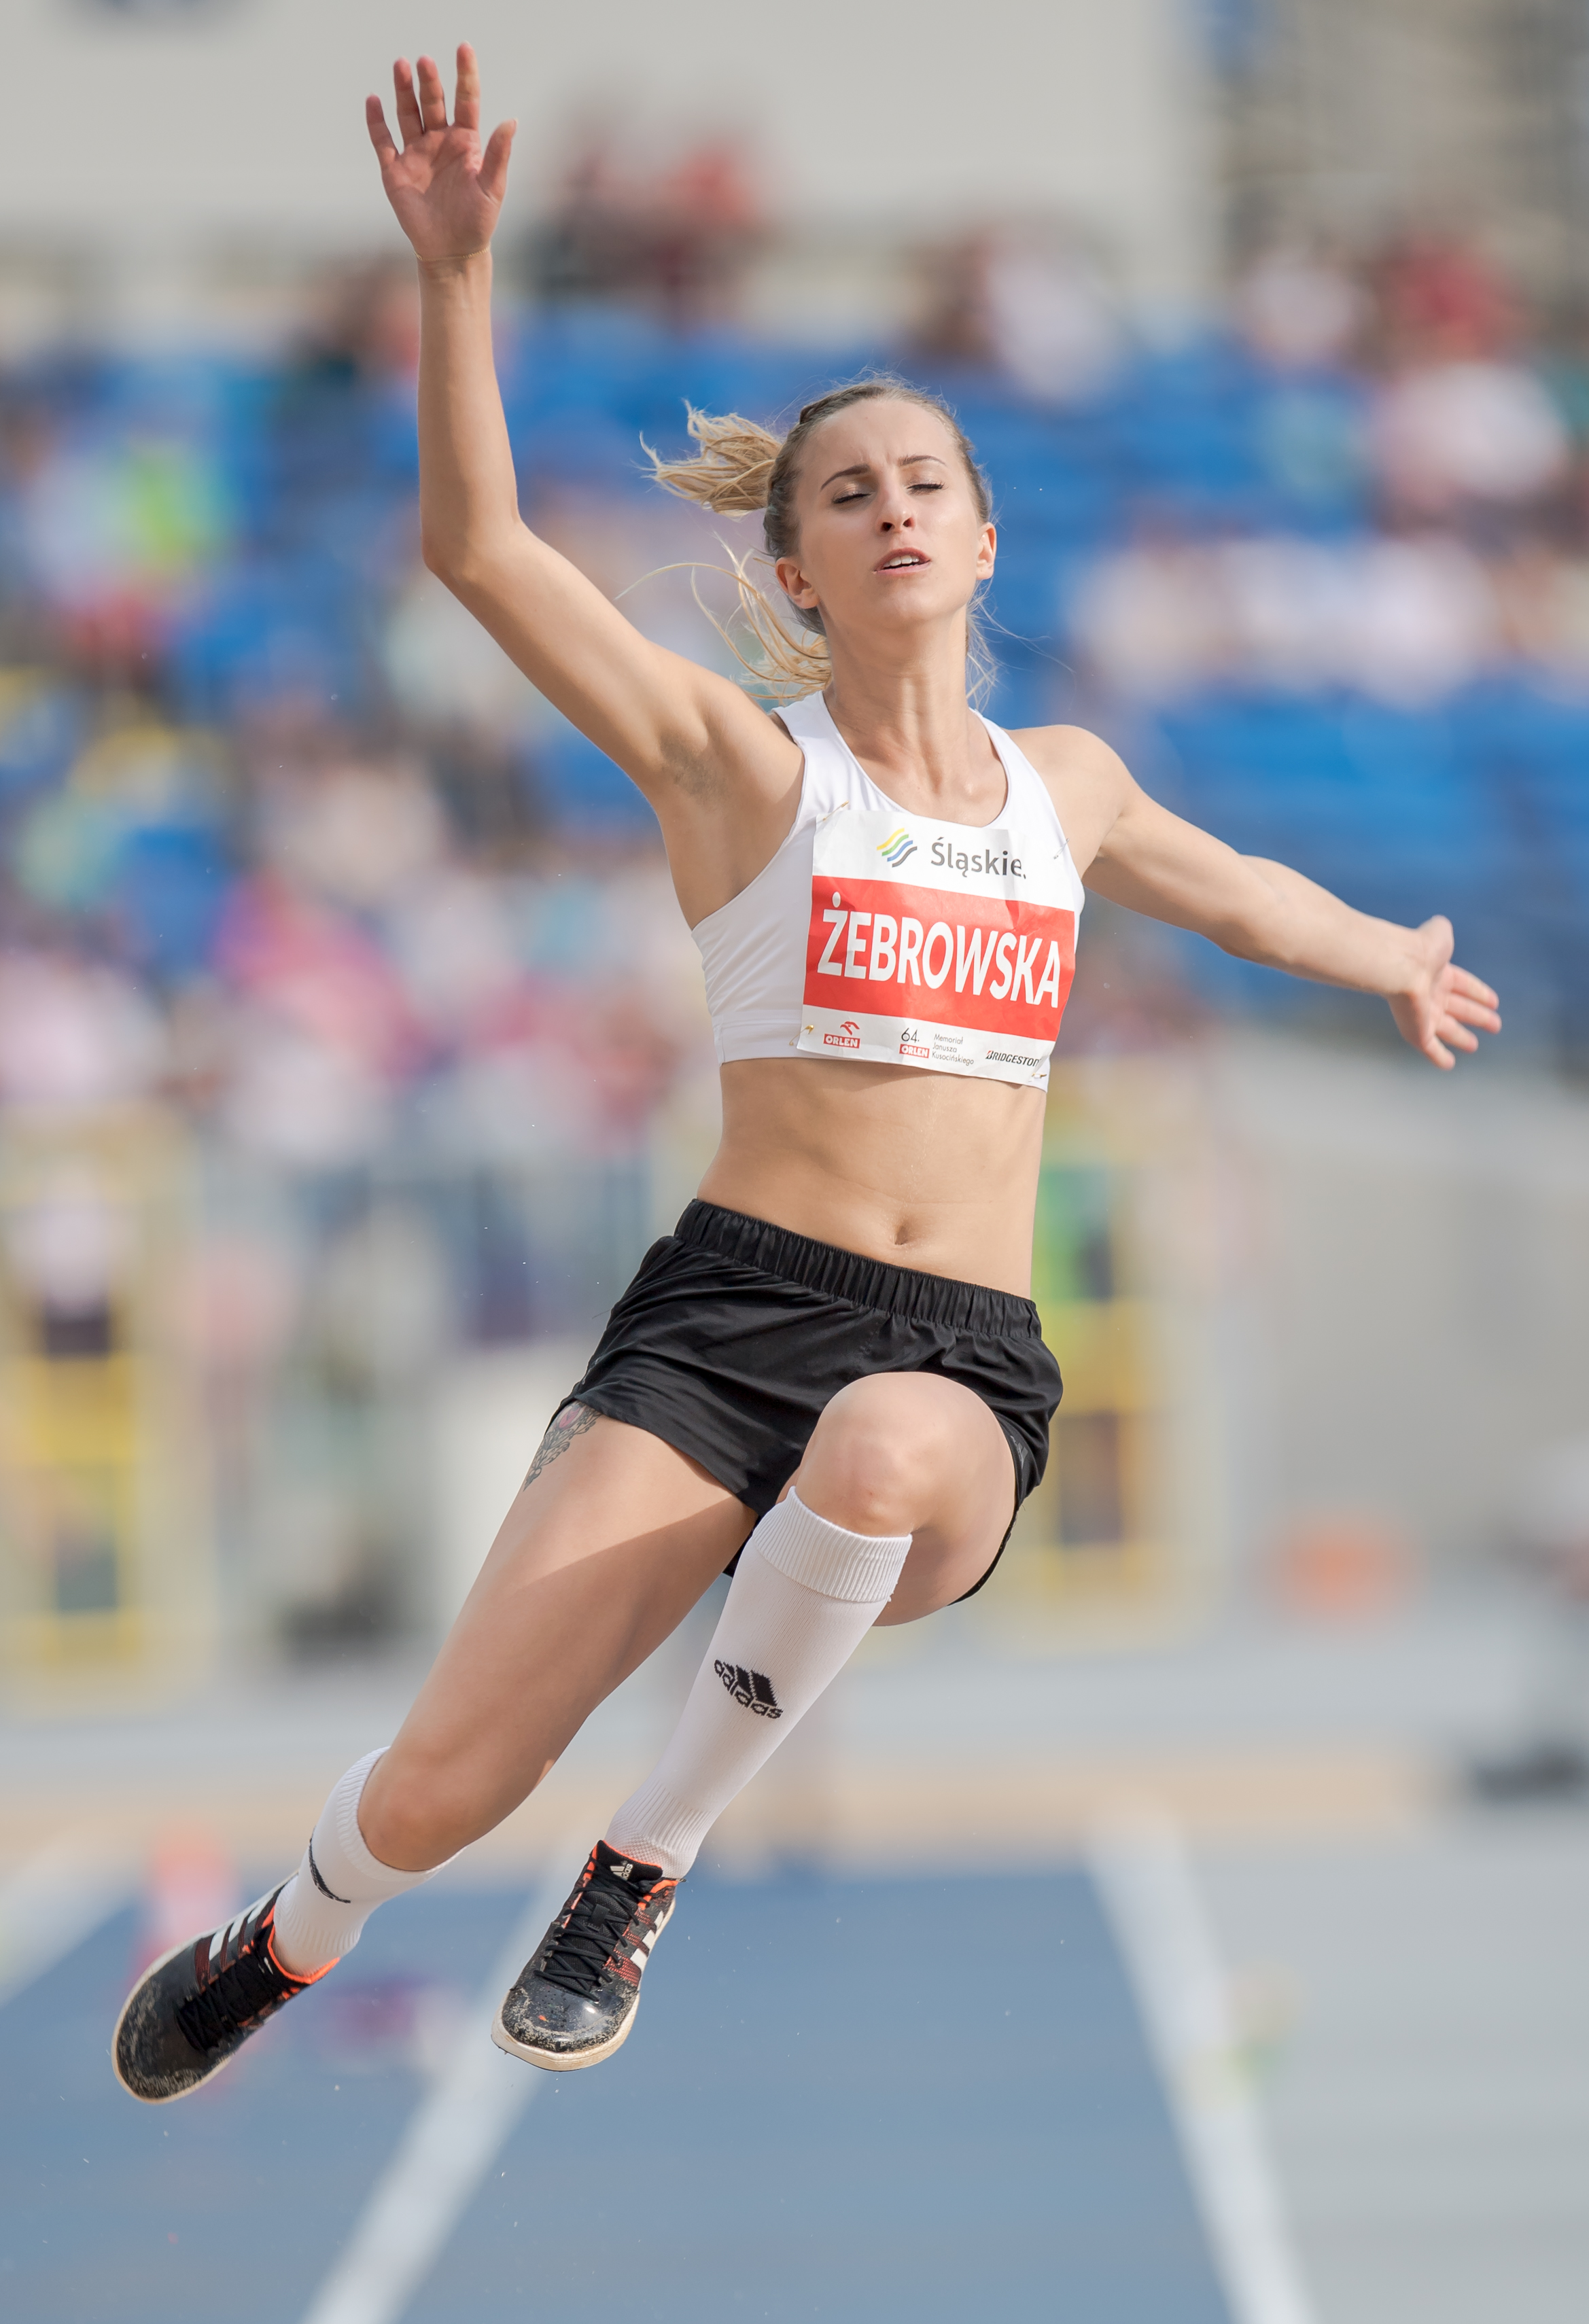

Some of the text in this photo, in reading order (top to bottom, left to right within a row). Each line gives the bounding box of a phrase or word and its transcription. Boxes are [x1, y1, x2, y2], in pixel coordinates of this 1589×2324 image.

[817, 891, 1061, 1008] ŻEBROWSKA
[824, 1034, 859, 1048] ORLEN
[901, 1027, 920, 1043] 64.
[934, 1034, 964, 1044] Memoriał
[901, 1045, 928, 1057] ORLEN
[932, 1042, 958, 1053] Janusza
[932, 1051, 975, 1066] Kusocińskiego
[985, 1051, 1042, 1067] BRIDGESTON
[714, 1659, 783, 1719] adidas
